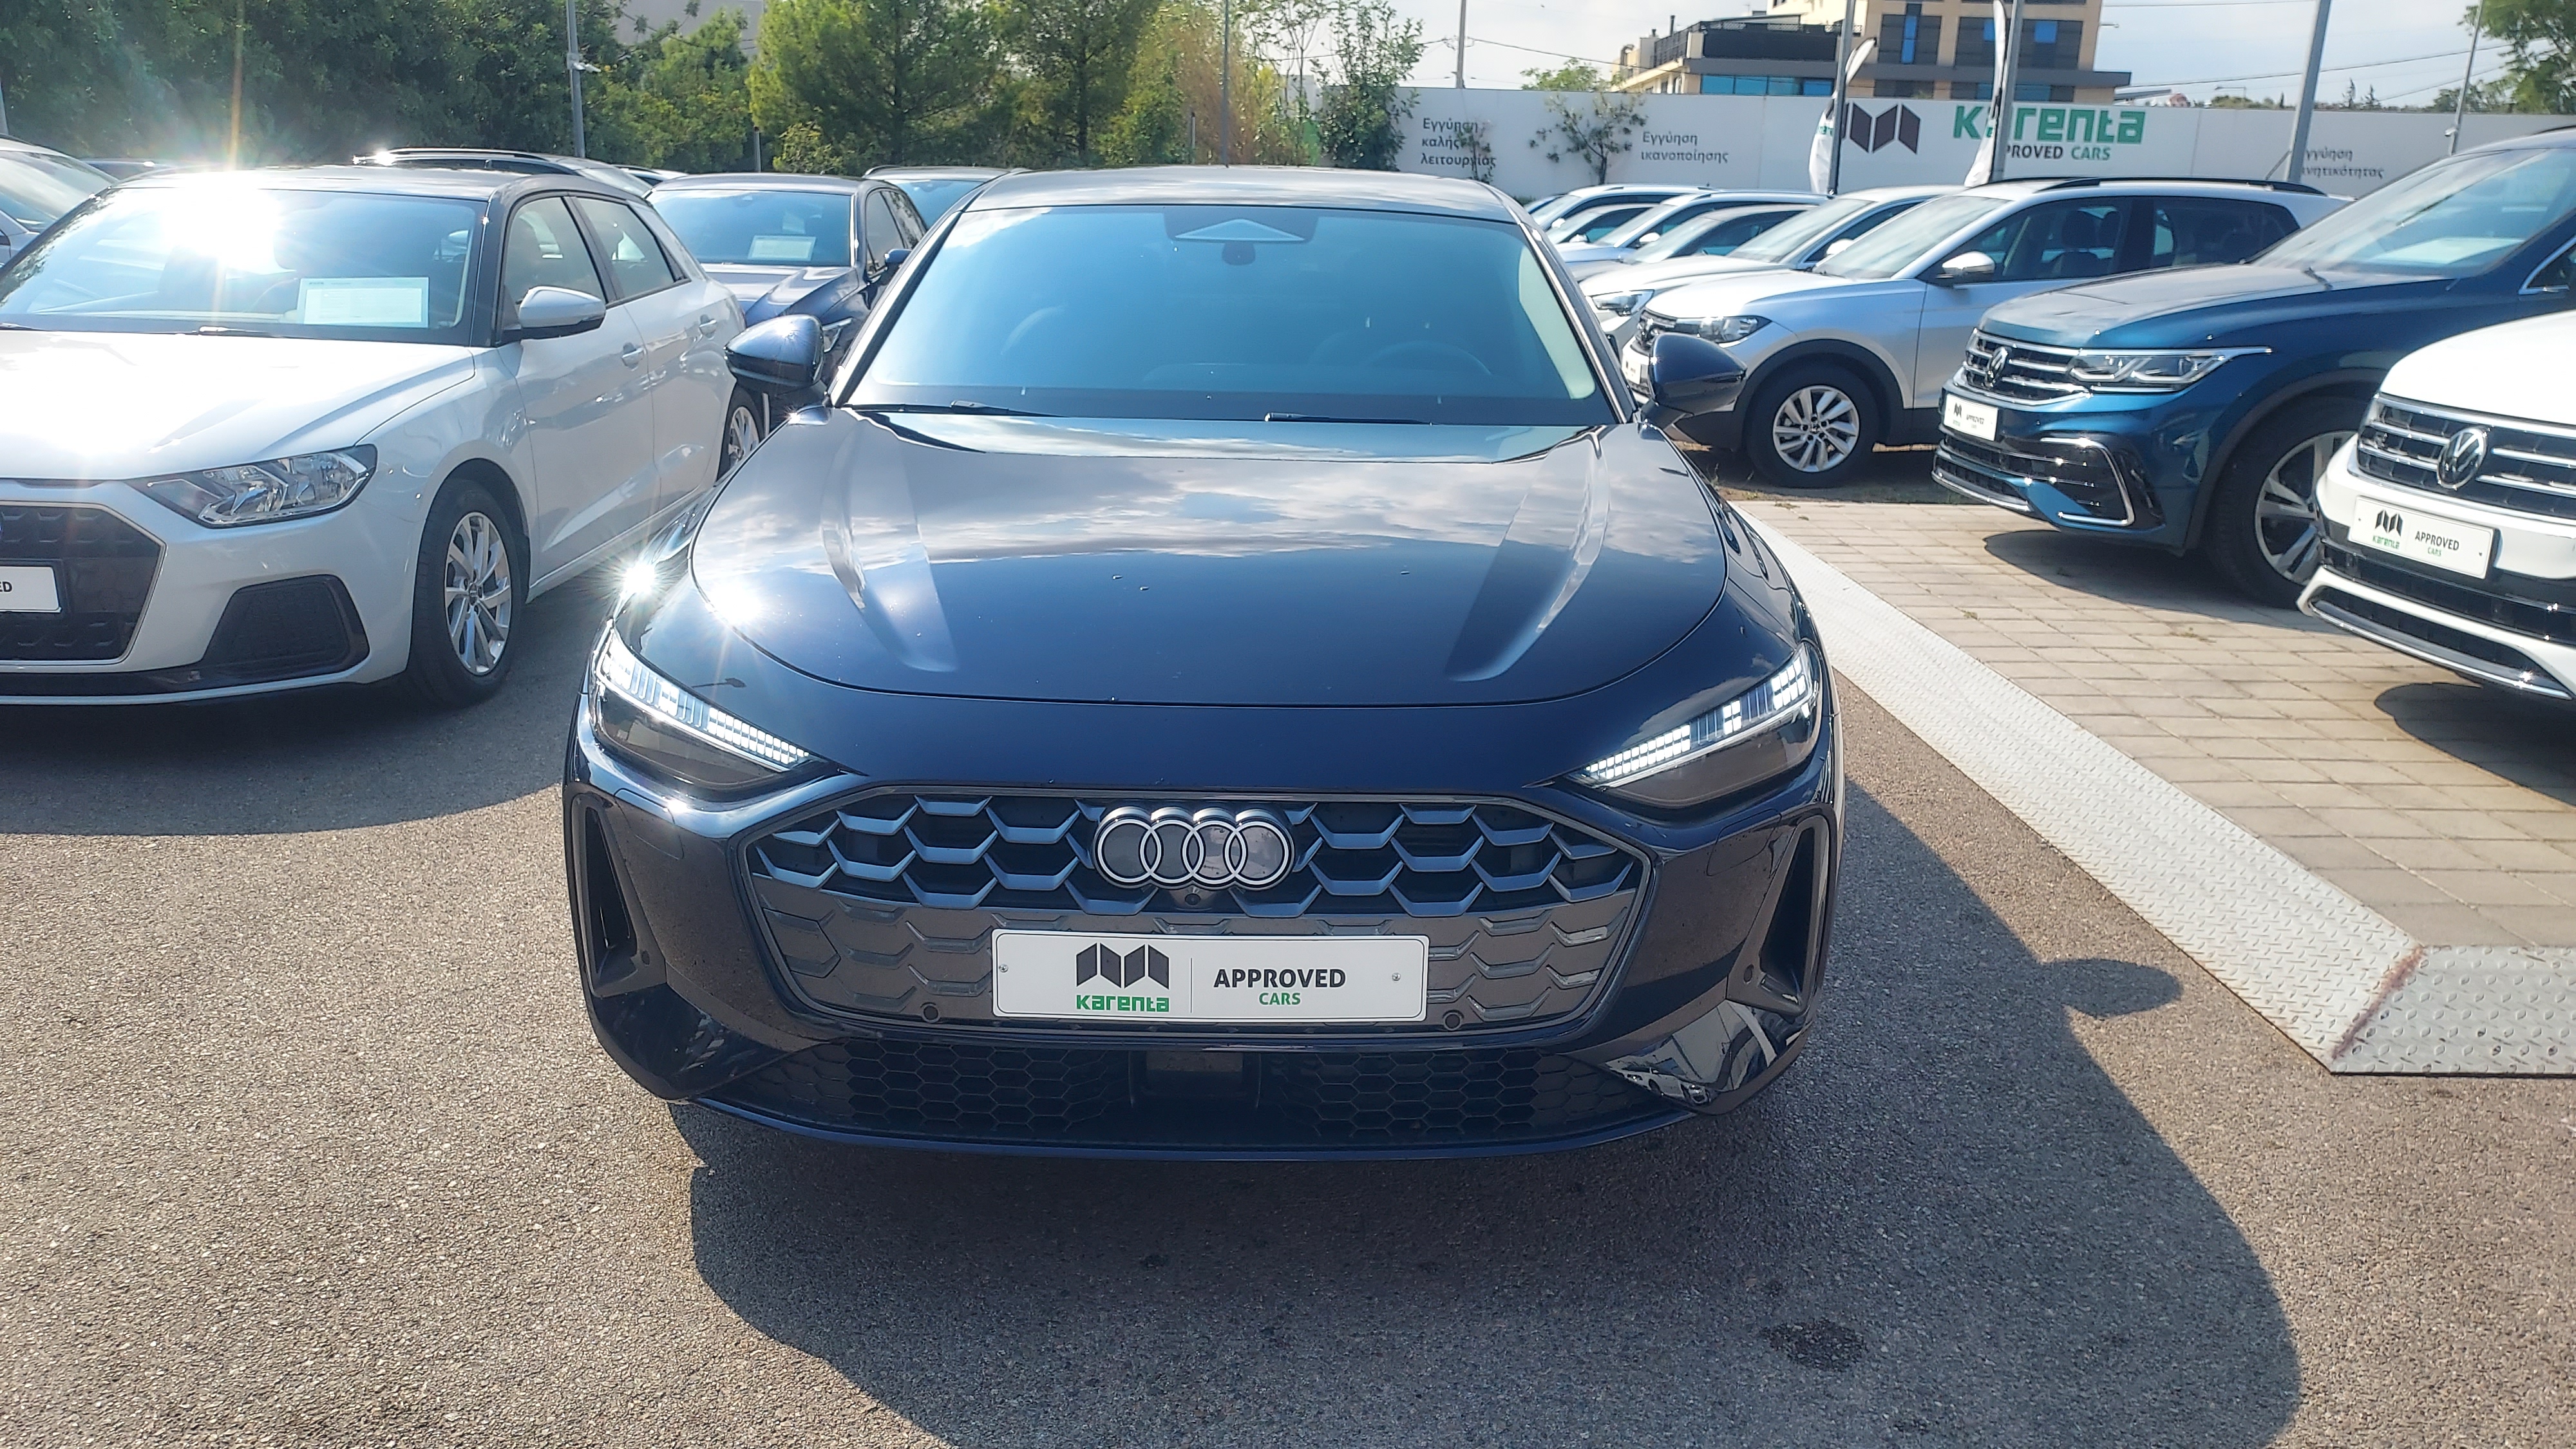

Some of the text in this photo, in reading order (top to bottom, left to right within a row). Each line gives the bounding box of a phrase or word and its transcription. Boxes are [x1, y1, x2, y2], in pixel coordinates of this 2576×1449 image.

[1953, 106, 2146, 144] Krenta
[1422, 135, 1459, 150] καλής
[1643, 131, 1698, 146] Εγγύηση
[1642, 149, 1728, 164] ικανοποίησης
[2072, 147, 2111, 160] CARS
[2306, 146, 2353, 162] γγύηση
[2415, 531, 2459, 551] APPROVED
[1213, 969, 1347, 988] APPROVED
[1076, 994, 1170, 1012] Karenta
[1258, 992, 1302, 1005] CARS
